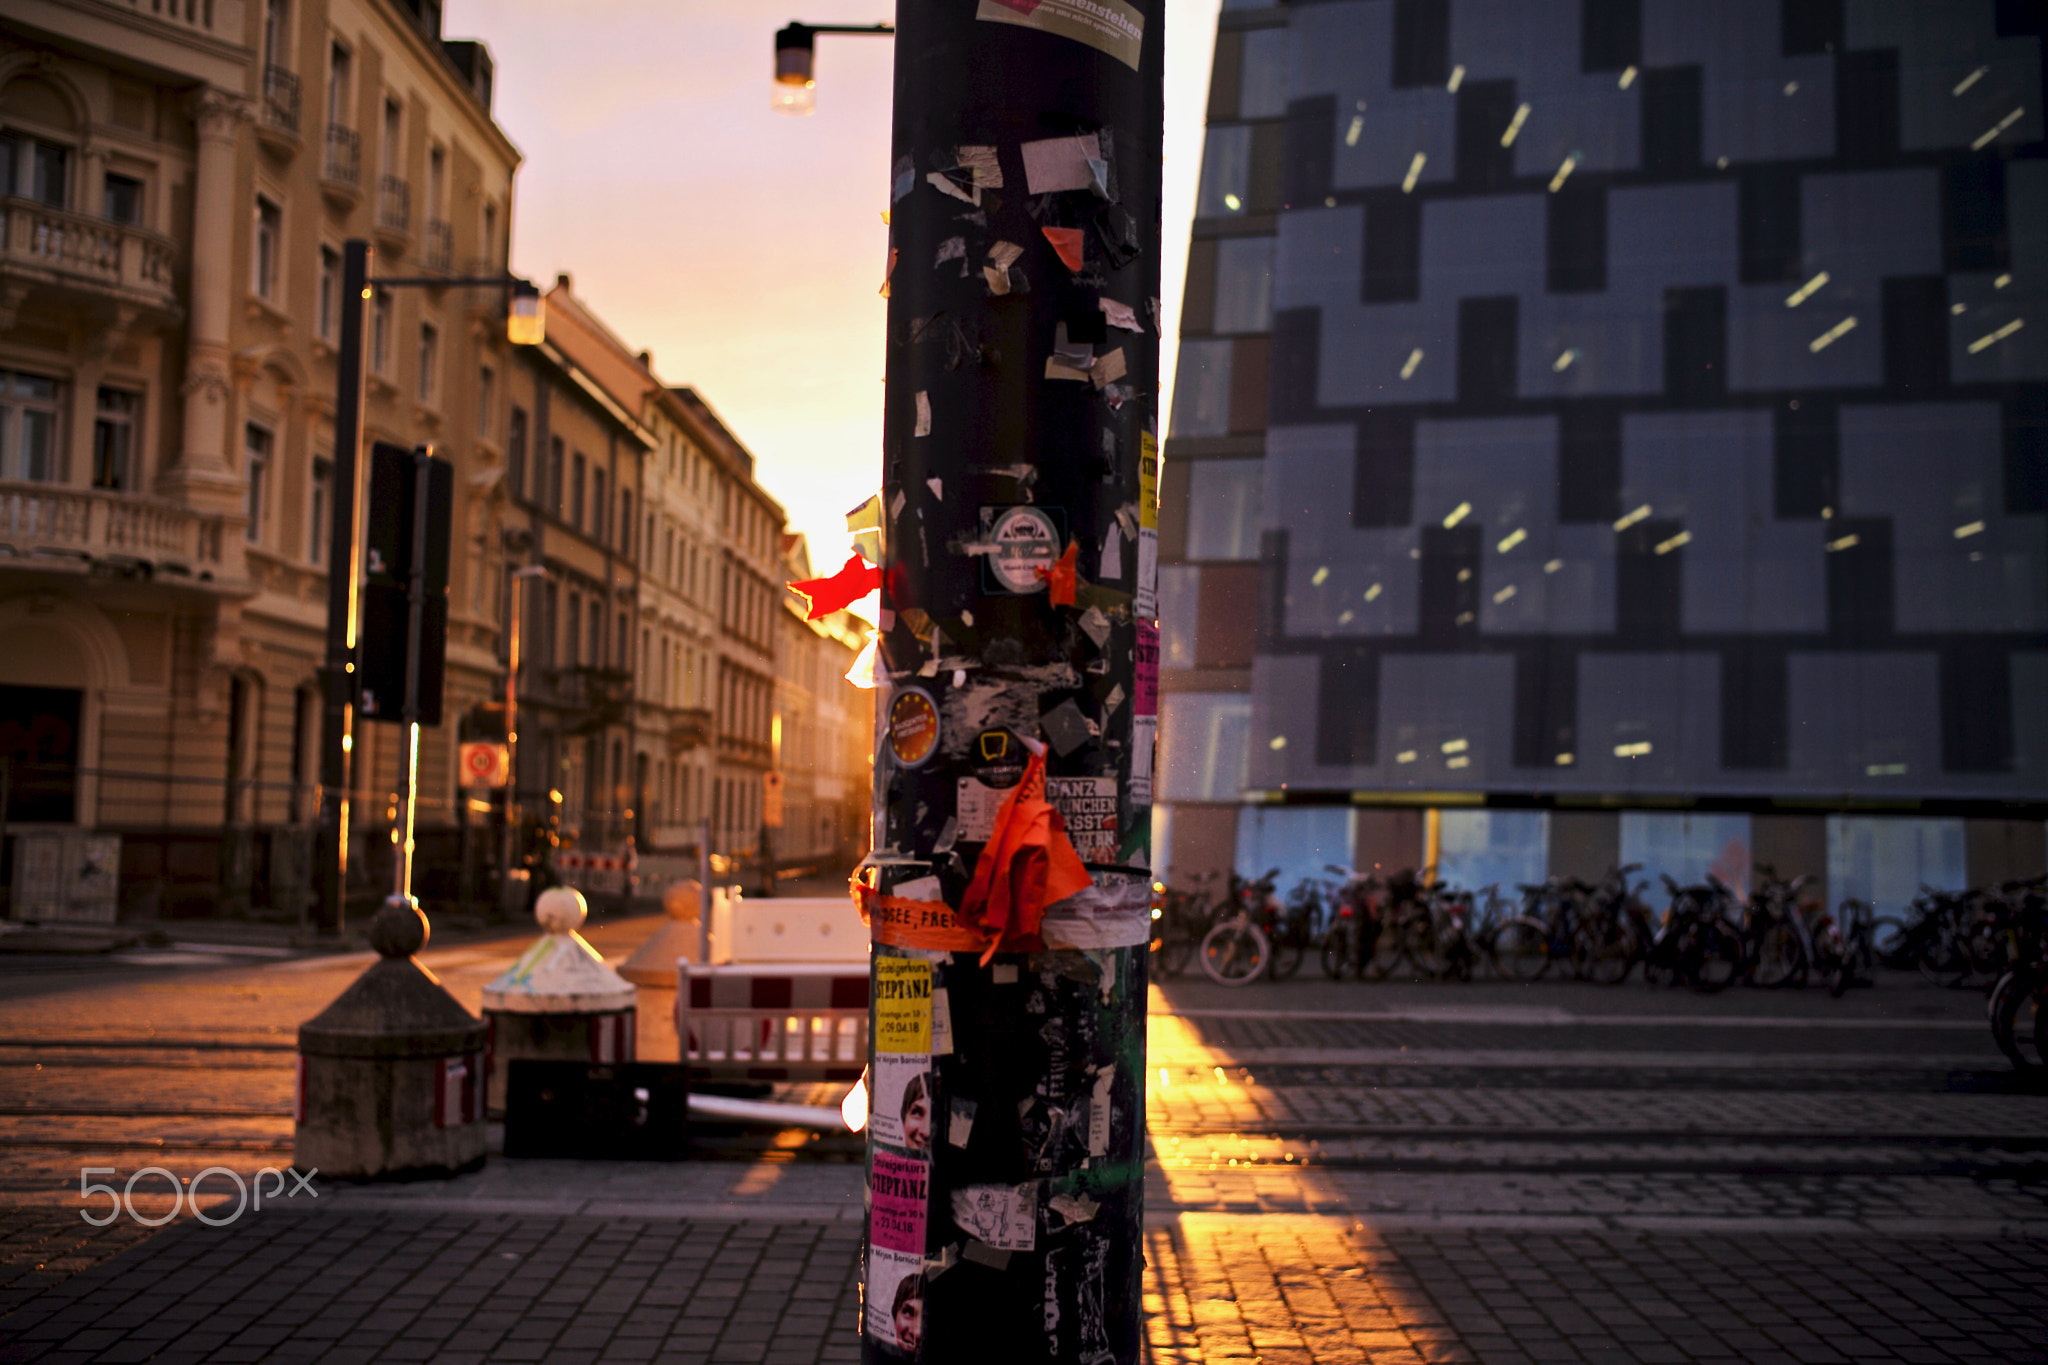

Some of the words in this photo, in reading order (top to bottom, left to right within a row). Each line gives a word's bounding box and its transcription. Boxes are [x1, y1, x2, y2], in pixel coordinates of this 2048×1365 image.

[876, 979, 931, 999] STEPTANZ
[885, 1022, 920, 1033] 09.04.18
[881, 1216, 914, 1233] 23.04.18
